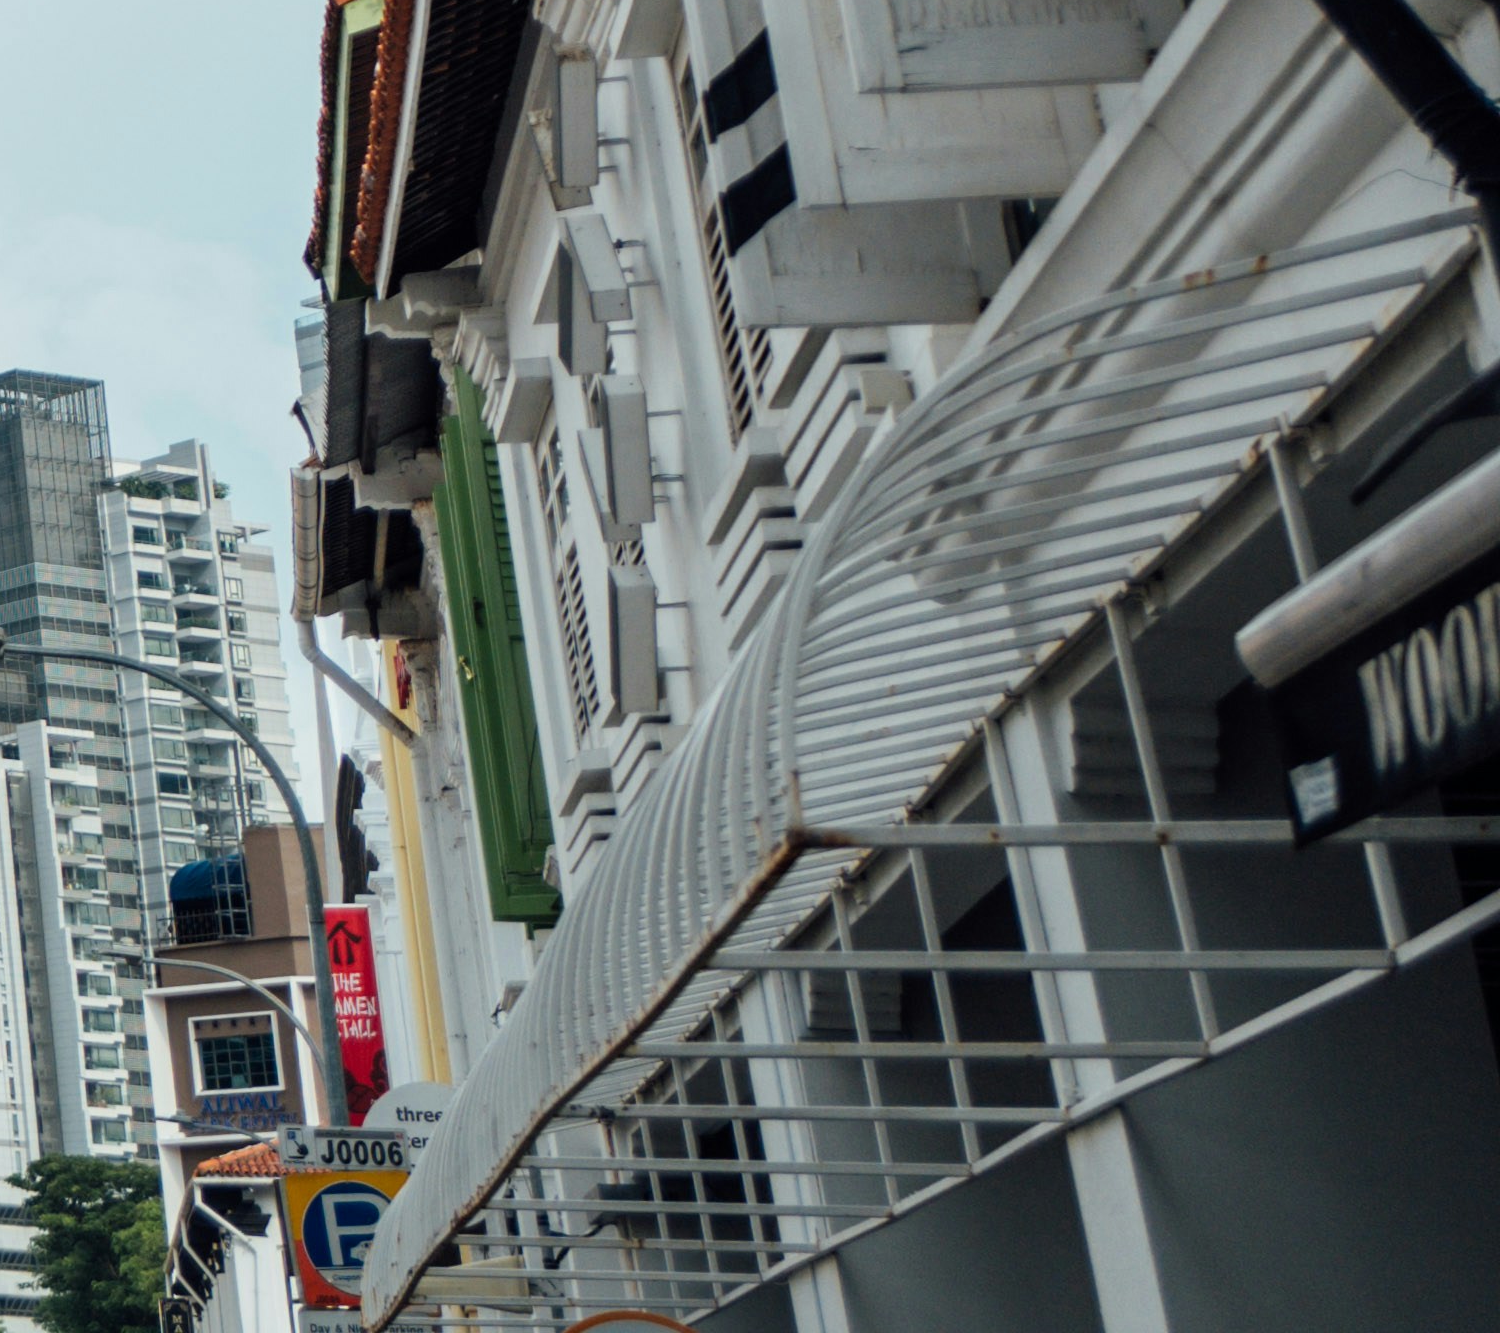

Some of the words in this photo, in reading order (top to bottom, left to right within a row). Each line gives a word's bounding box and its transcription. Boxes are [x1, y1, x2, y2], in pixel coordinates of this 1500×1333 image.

[331, 972, 363, 993] THE
[335, 995, 377, 1016] AMEN
[336, 1018, 377, 1039] TALL
[202, 1093, 282, 1113] ALIWAL
[321, 1139, 403, 1166] J0006
